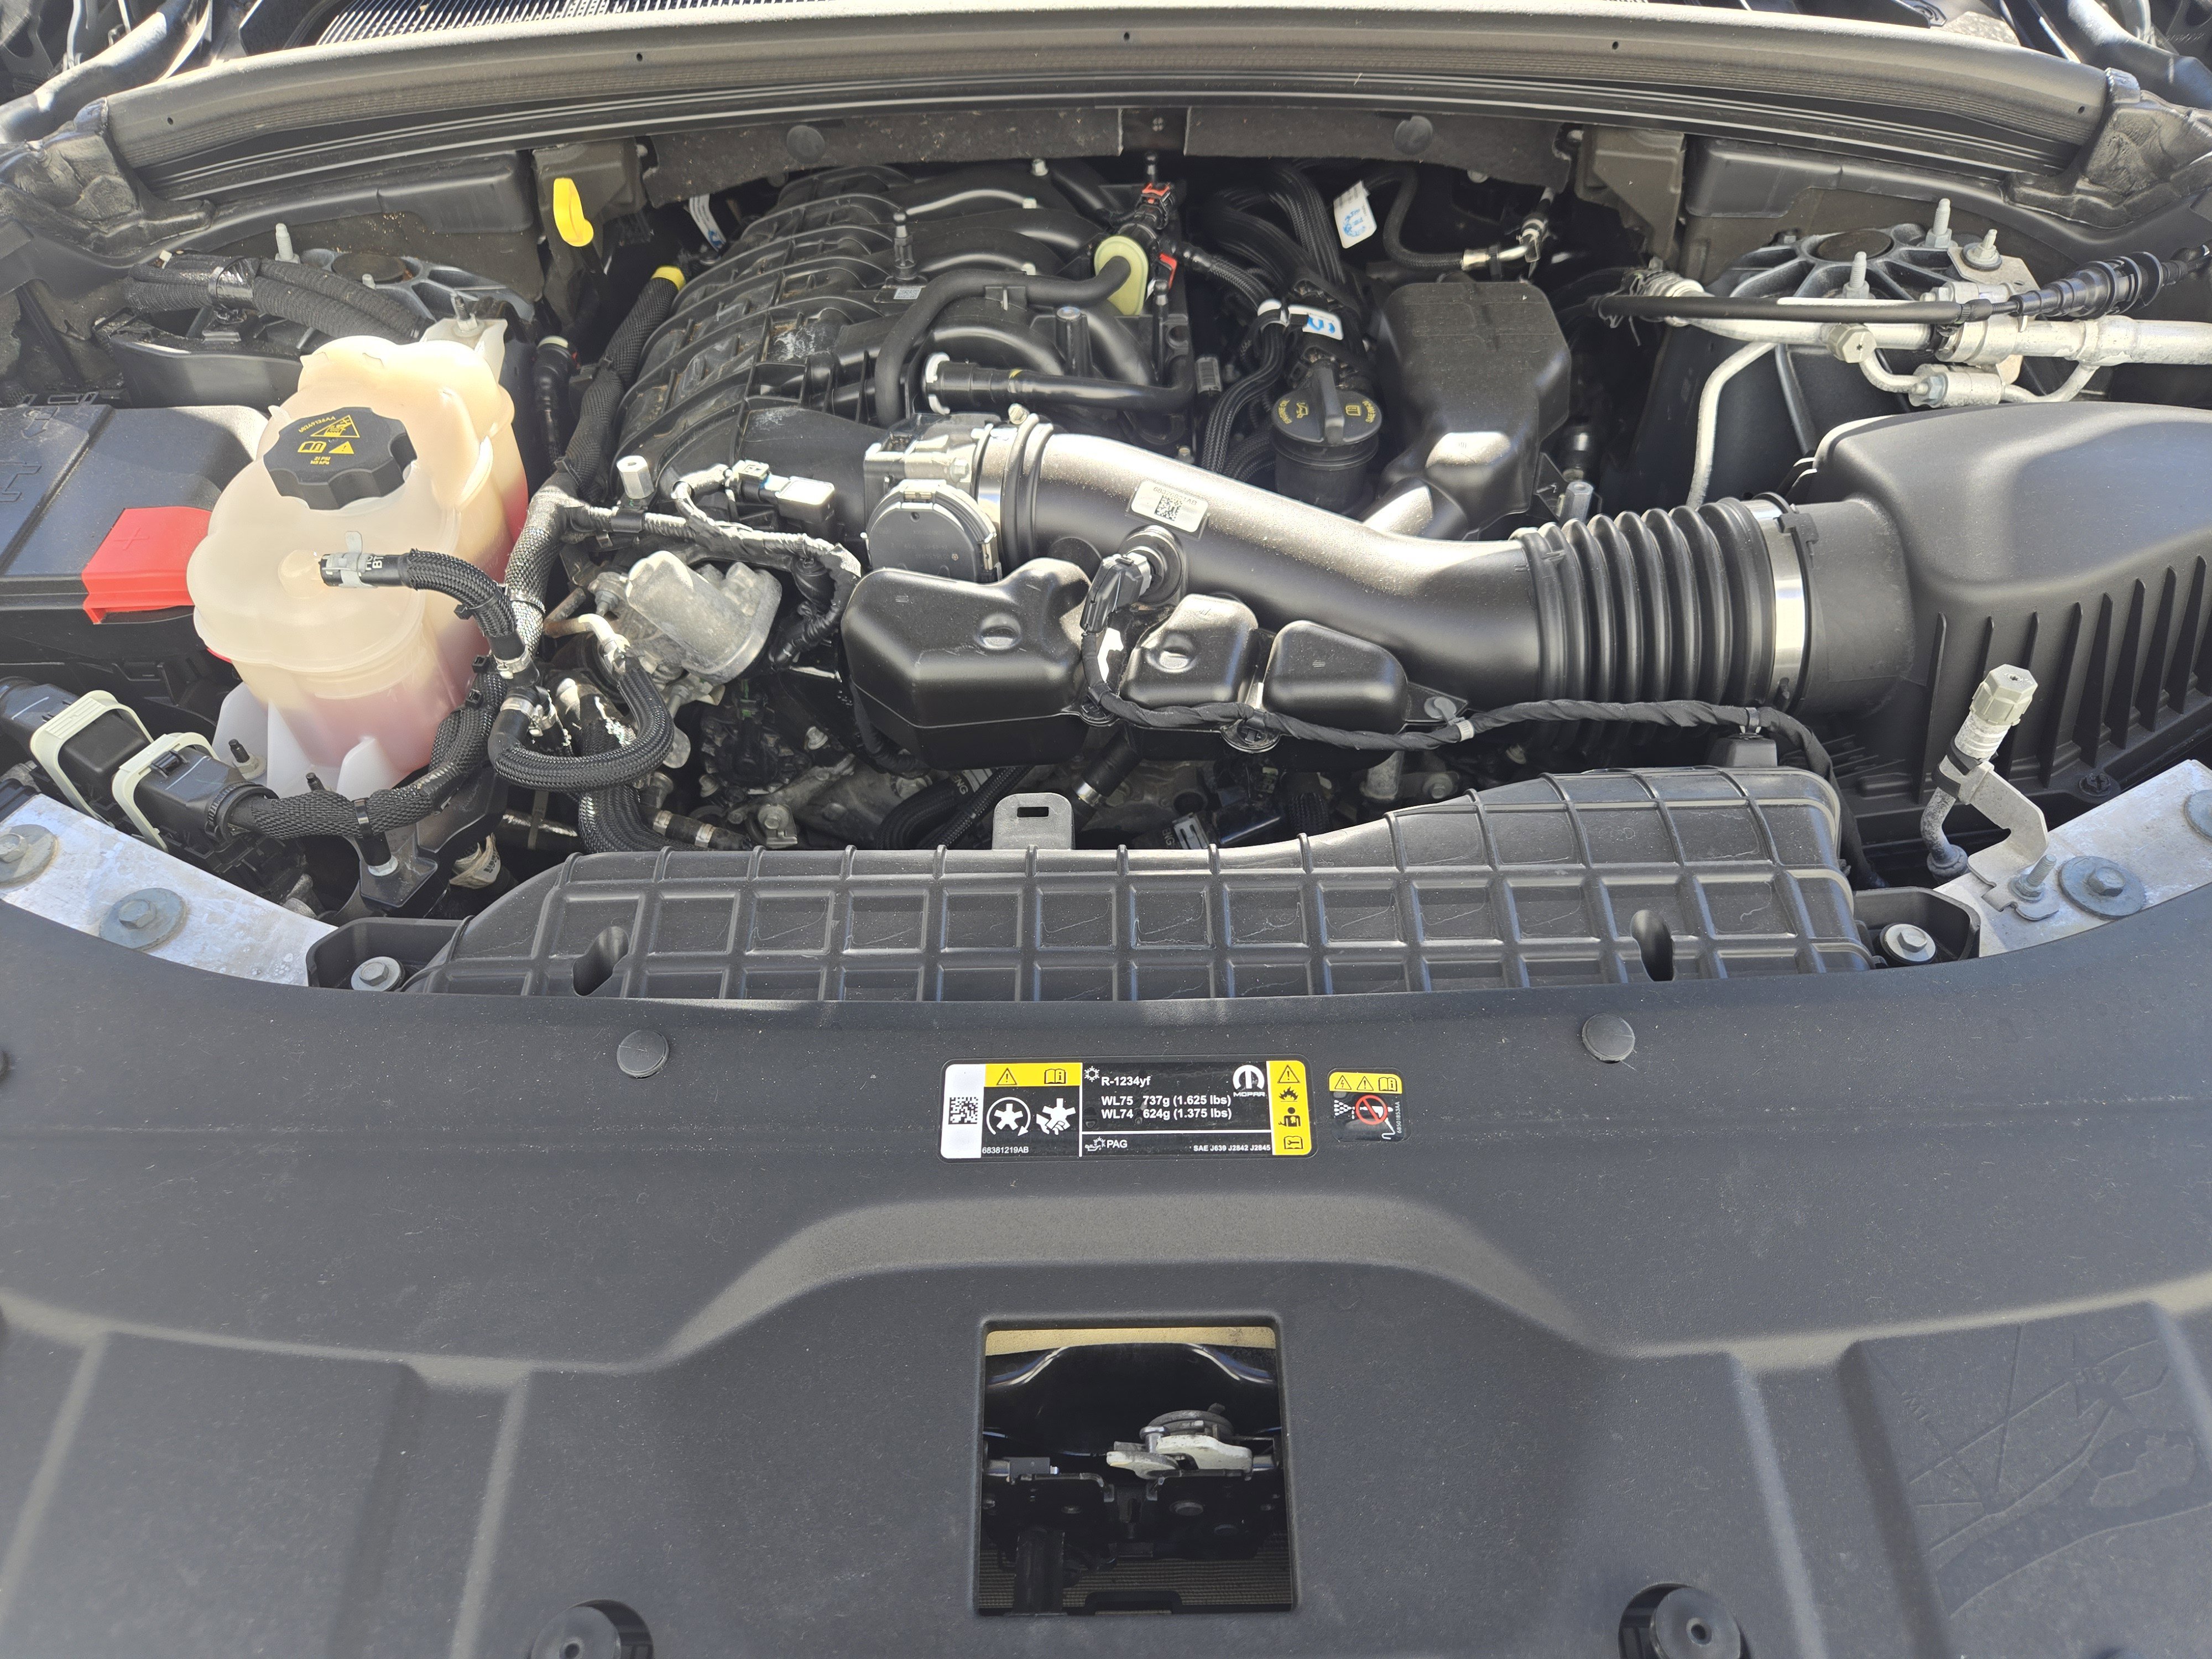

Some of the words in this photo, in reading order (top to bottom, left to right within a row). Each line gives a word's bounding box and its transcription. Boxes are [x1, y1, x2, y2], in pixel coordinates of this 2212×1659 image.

[1101, 1076, 1151, 1088] R-1234yf
[1100, 1095, 1134, 1105] WL75
[1142, 1095, 1170, 1107] 737g
[1173, 1095, 1207, 1107] (1.625
[1210, 1094, 1232, 1107] lbs)
[1100, 1109, 1134, 1119] WL74
[1142, 1108, 1170, 1120] 624g
[1173, 1108, 1208, 1120] (1.375
[1211, 1108, 1232, 1120] lbs)
[1107, 1139, 1128, 1149] PAG
